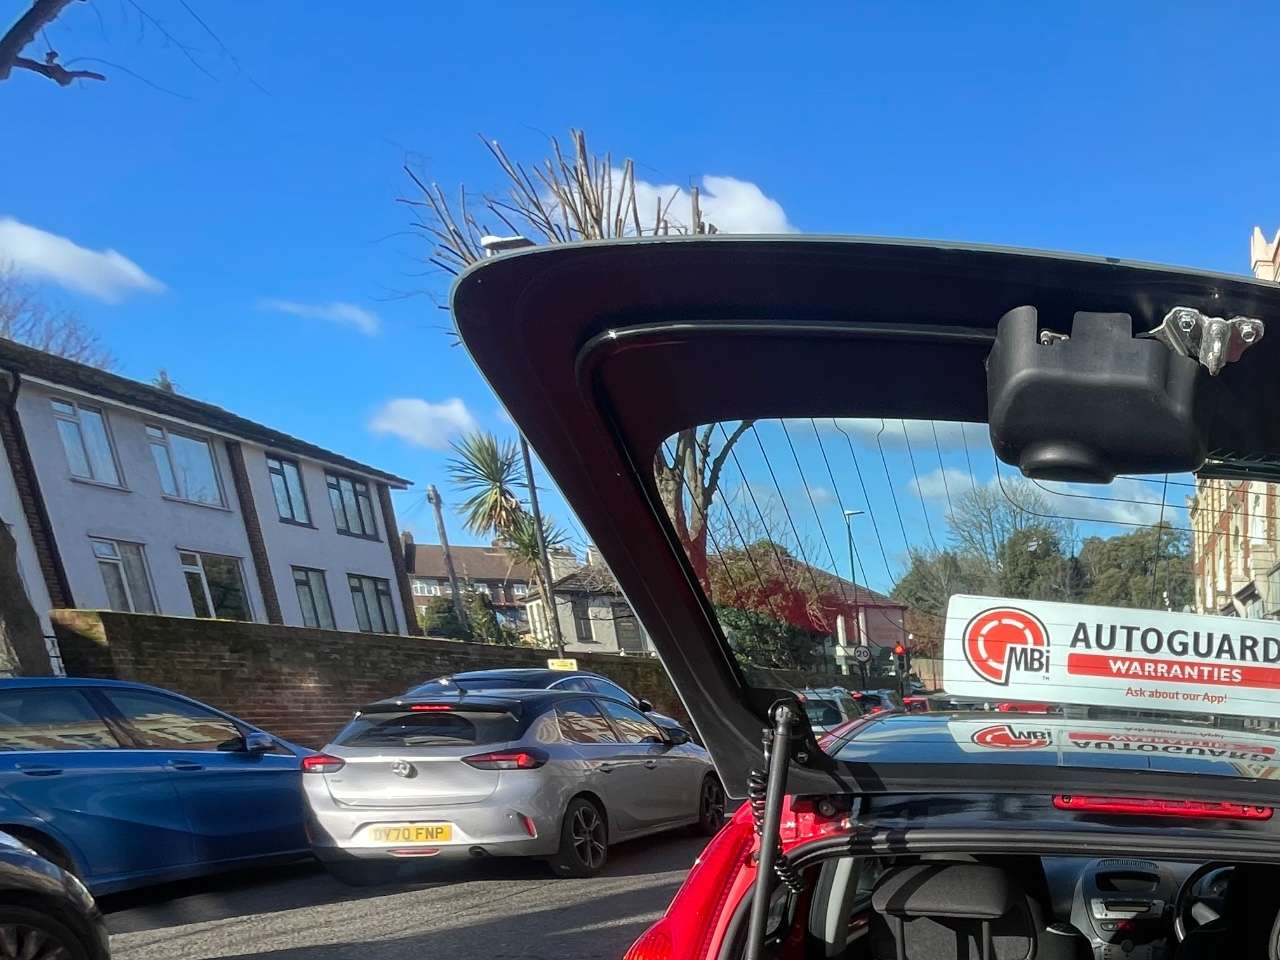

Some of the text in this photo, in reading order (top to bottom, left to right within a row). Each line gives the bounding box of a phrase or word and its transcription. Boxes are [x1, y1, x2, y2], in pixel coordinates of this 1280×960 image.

[1109, 659, 1242, 683] WARRANTIES
[1125, 687, 1227, 704] Ask about our App!
[415, 827, 444, 840] FNP
